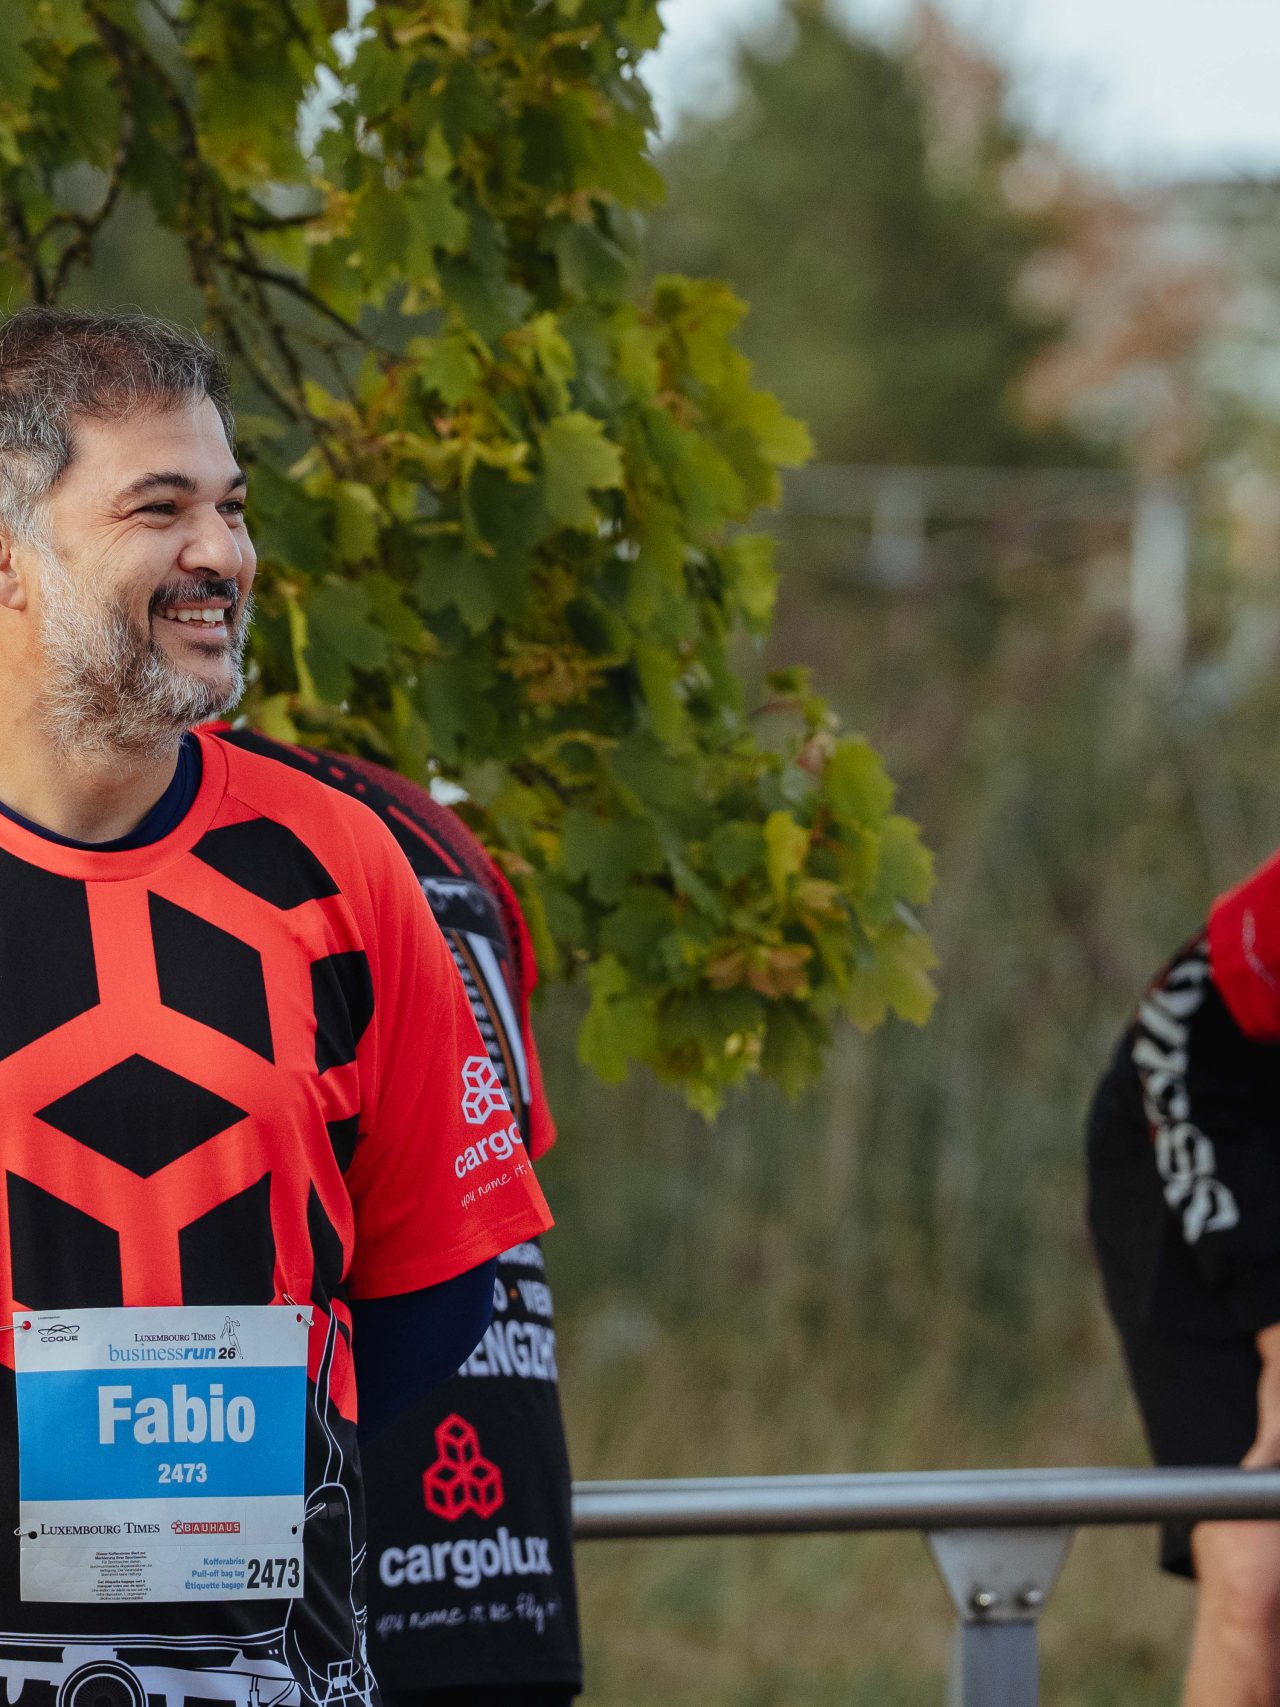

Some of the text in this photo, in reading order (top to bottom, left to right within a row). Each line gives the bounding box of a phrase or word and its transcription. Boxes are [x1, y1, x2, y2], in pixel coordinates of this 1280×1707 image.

[478, 1173, 512, 1197] name
[40, 1335, 79, 1343] COQUE
[191, 1332, 217, 1341] TIMES
[217, 1347, 236, 1360] 26
[98, 1383, 256, 1445] Fabio
[158, 1462, 208, 1484] 2473
[123, 1522, 161, 1534] TIMES
[184, 1522, 240, 1534] BAUHAUS
[378, 1526, 553, 1589] cargolux
[191, 1569, 245, 1578] Pull-off bag tag
[246, 1557, 300, 1589] 2473
[221, 1582, 245, 1591] bagage
[409, 1606, 466, 1628] name
